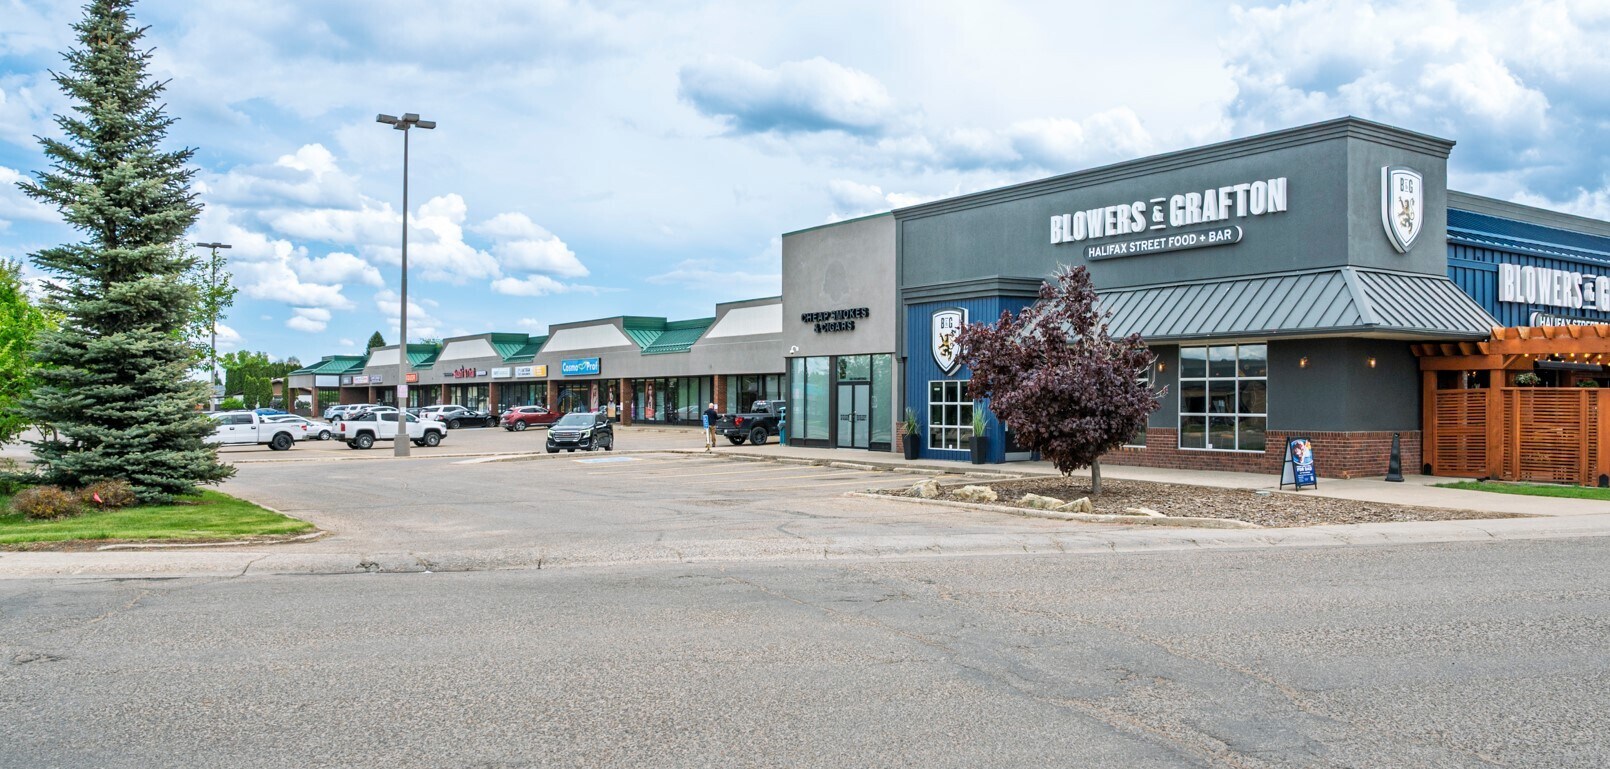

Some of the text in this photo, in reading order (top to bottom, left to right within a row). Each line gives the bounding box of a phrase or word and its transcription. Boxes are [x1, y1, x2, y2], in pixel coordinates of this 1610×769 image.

[1050, 177, 1287, 244] BLOWERS & GRAFTON
[1088, 243, 1127, 258] HALIFAX
[1129, 237, 1166, 252] STREET
[1168, 234, 1197, 247] FOOD
[1208, 229, 1232, 243] BAR
[1499, 263, 1582, 309] BLOWERS
[801, 307, 869, 323] CHEAP SMOKES
[820, 321, 855, 333] CIGARS
[562, 360, 598, 372] Cosmo Prof
